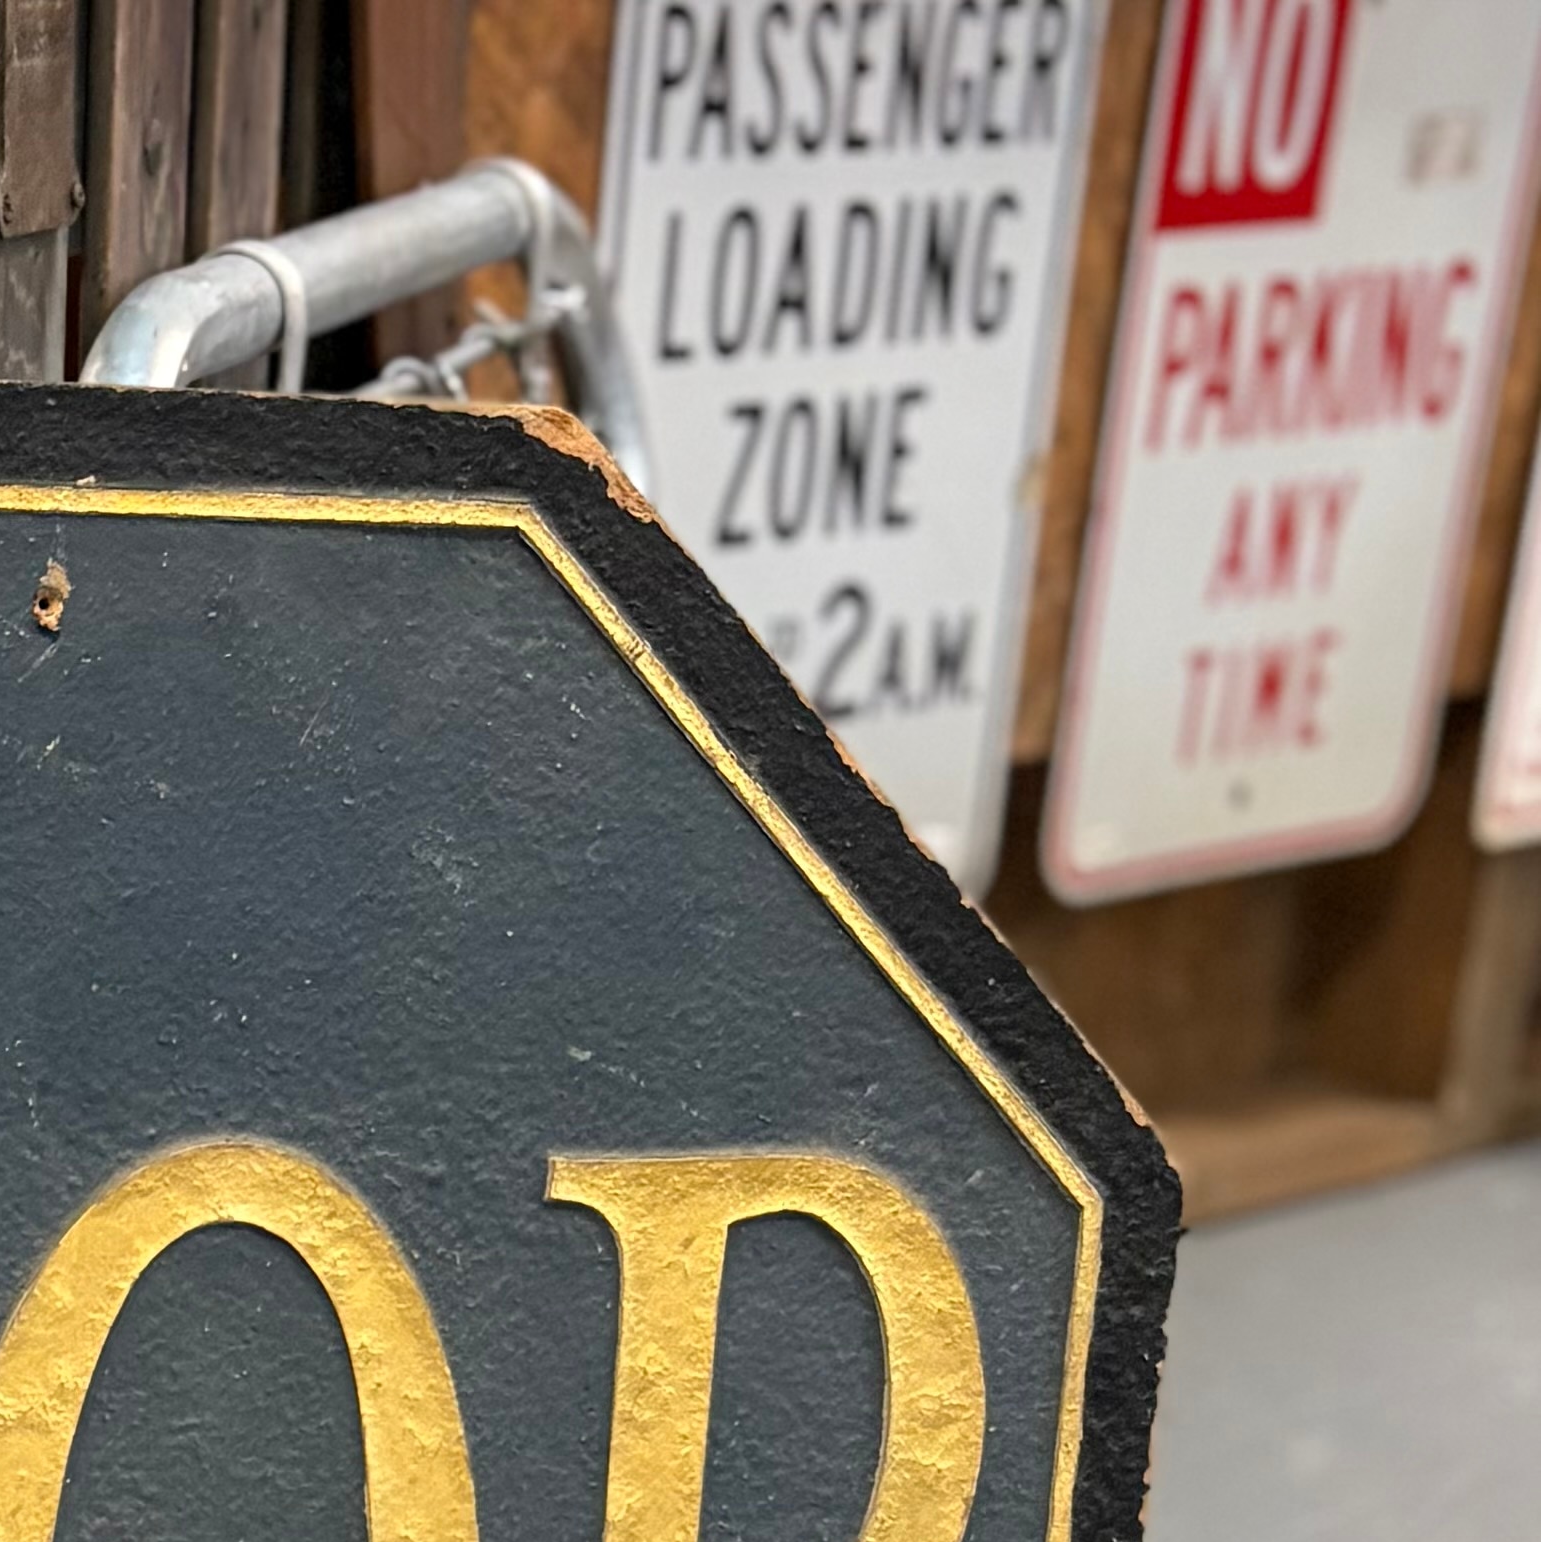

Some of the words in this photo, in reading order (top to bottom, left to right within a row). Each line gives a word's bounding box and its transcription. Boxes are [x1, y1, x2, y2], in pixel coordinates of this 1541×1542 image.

[648, 0, 1071, 161] PASSENGER
[1175, 0, 1335, 195] NO
[653, 194, 1023, 364] LOADING
[1144, 260, 1476, 452] PARKING
[712, 387, 927, 547] ZONE
[1205, 476, 1362, 611] ANY
[1175, 630, 1342, 769] TIME
